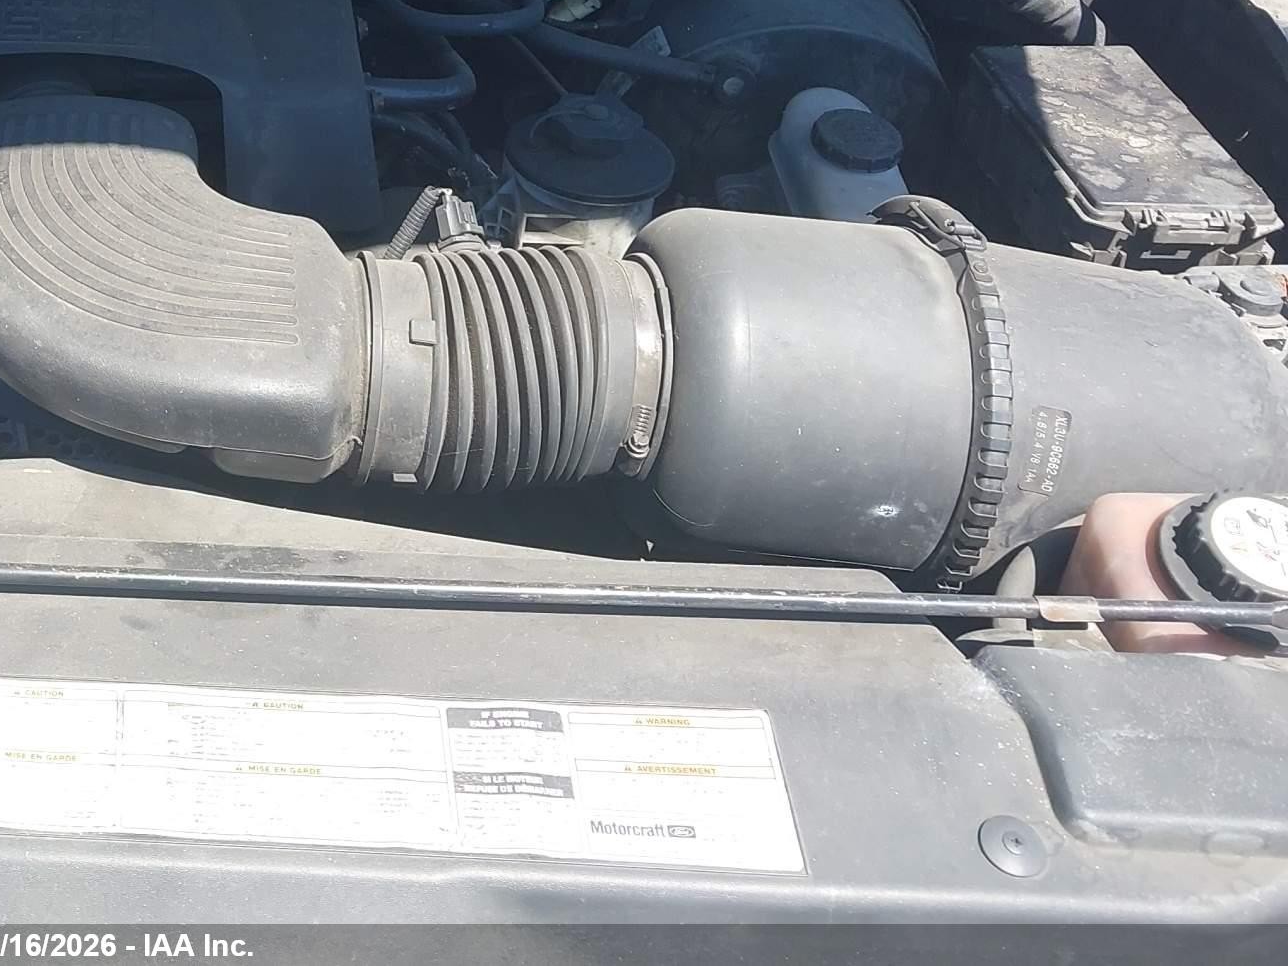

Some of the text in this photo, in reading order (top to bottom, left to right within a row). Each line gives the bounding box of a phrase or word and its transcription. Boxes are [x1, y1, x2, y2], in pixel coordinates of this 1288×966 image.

[647, 717, 691, 726] WARNING
[637, 765, 717, 775] AVERTISSEMENT
[590, 820, 666, 837] Motorcraft
